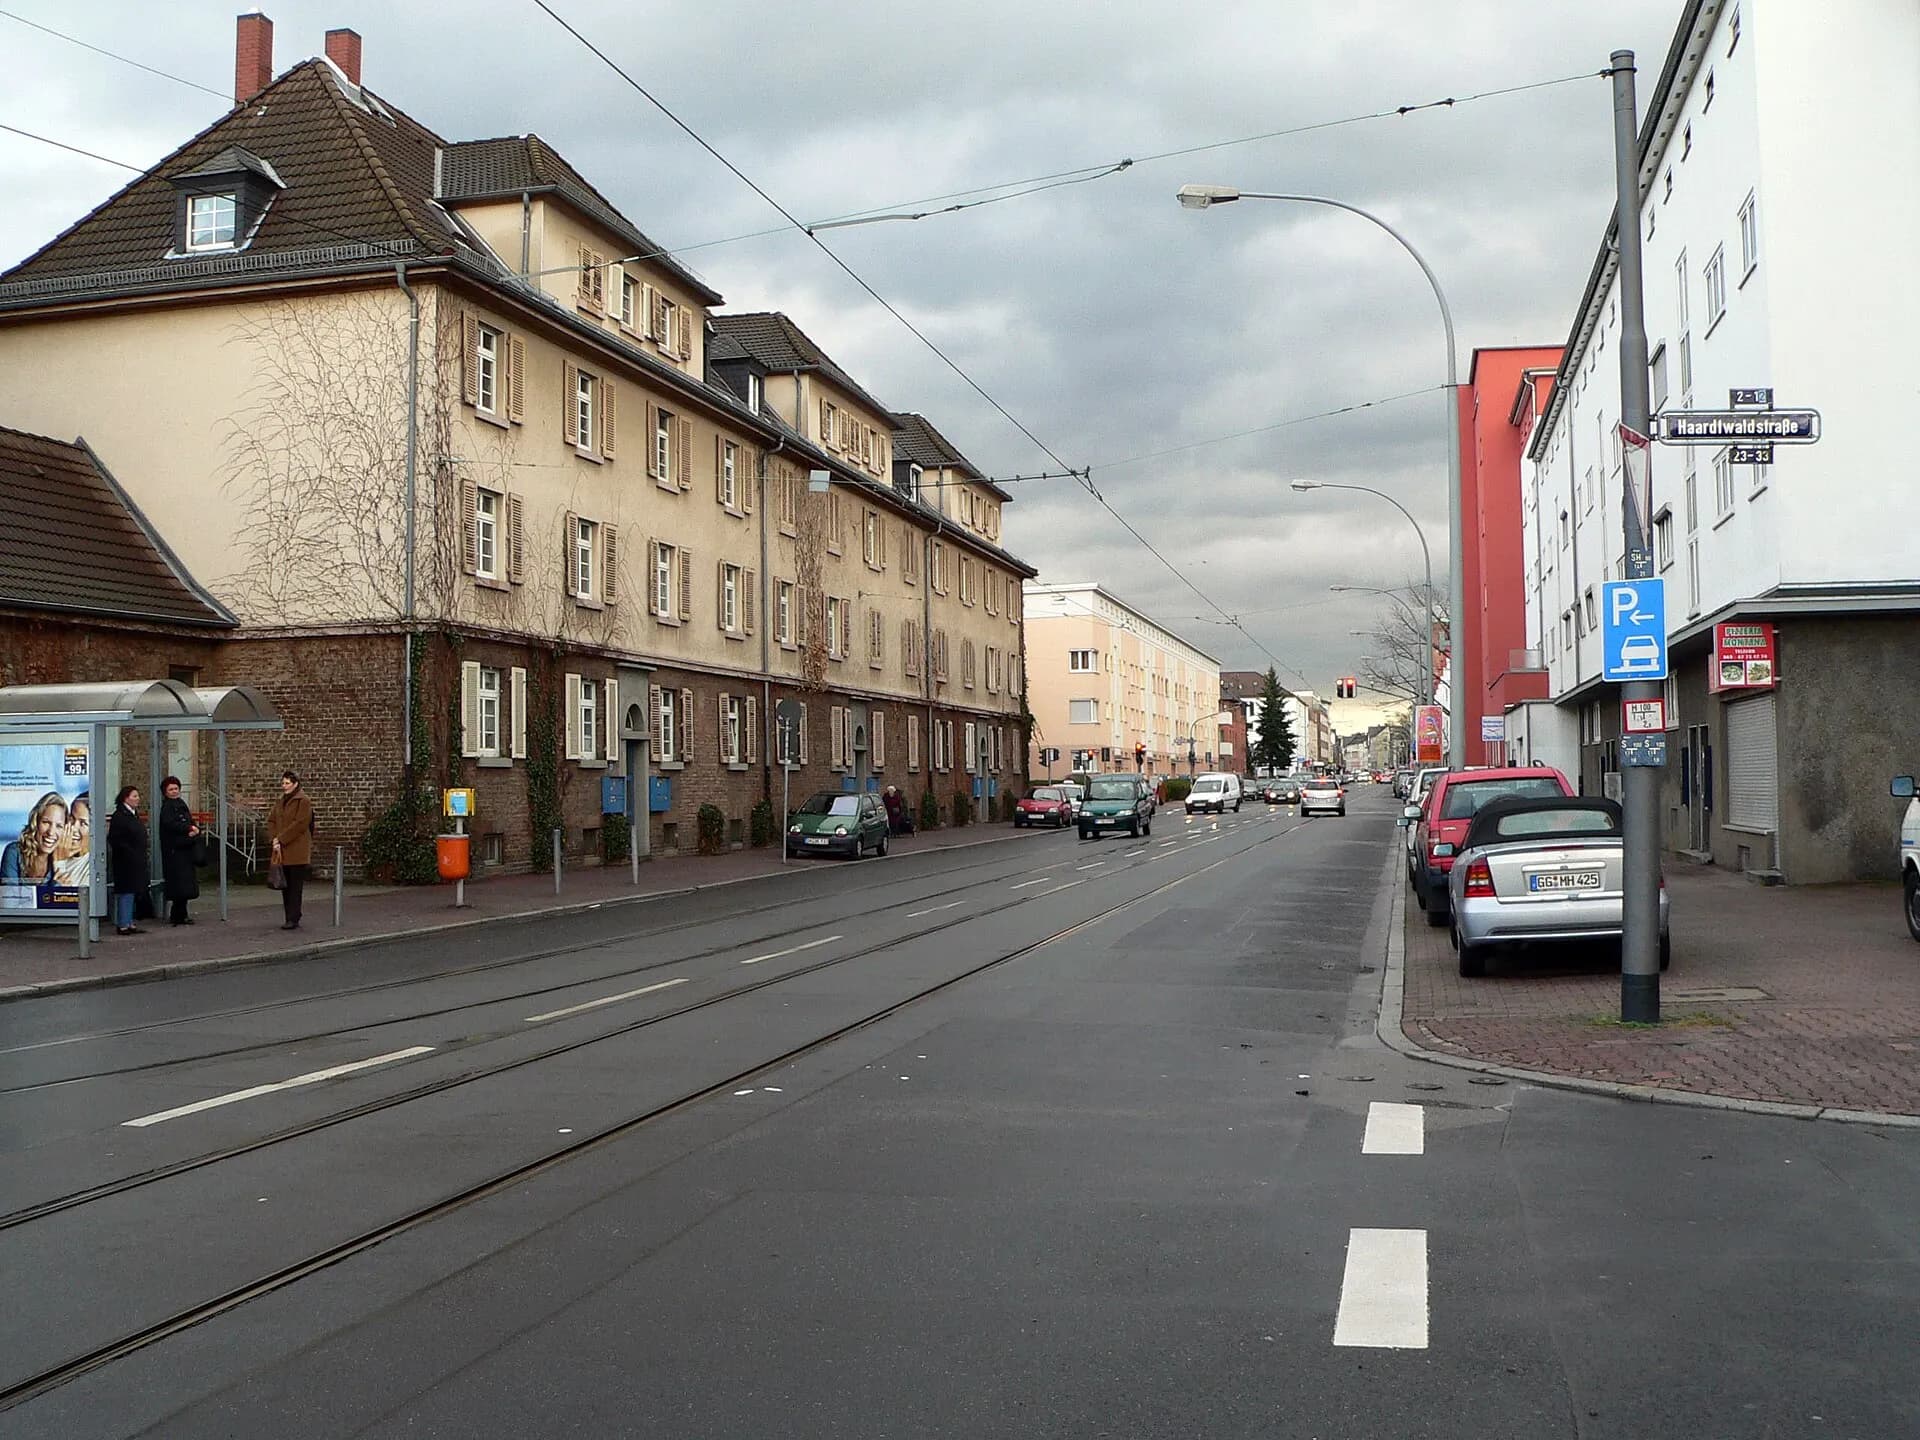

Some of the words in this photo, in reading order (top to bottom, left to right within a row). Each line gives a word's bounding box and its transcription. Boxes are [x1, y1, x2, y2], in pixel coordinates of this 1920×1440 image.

[1678, 418, 1799, 436] Haardtwaldstraße
[1733, 450, 1770, 462] 23-33
[1612, 588, 1639, 627] P
[1537, 876, 1553, 888] GG
[1559, 875, 1575, 887] MH
[1577, 873, 1598, 886] 425
